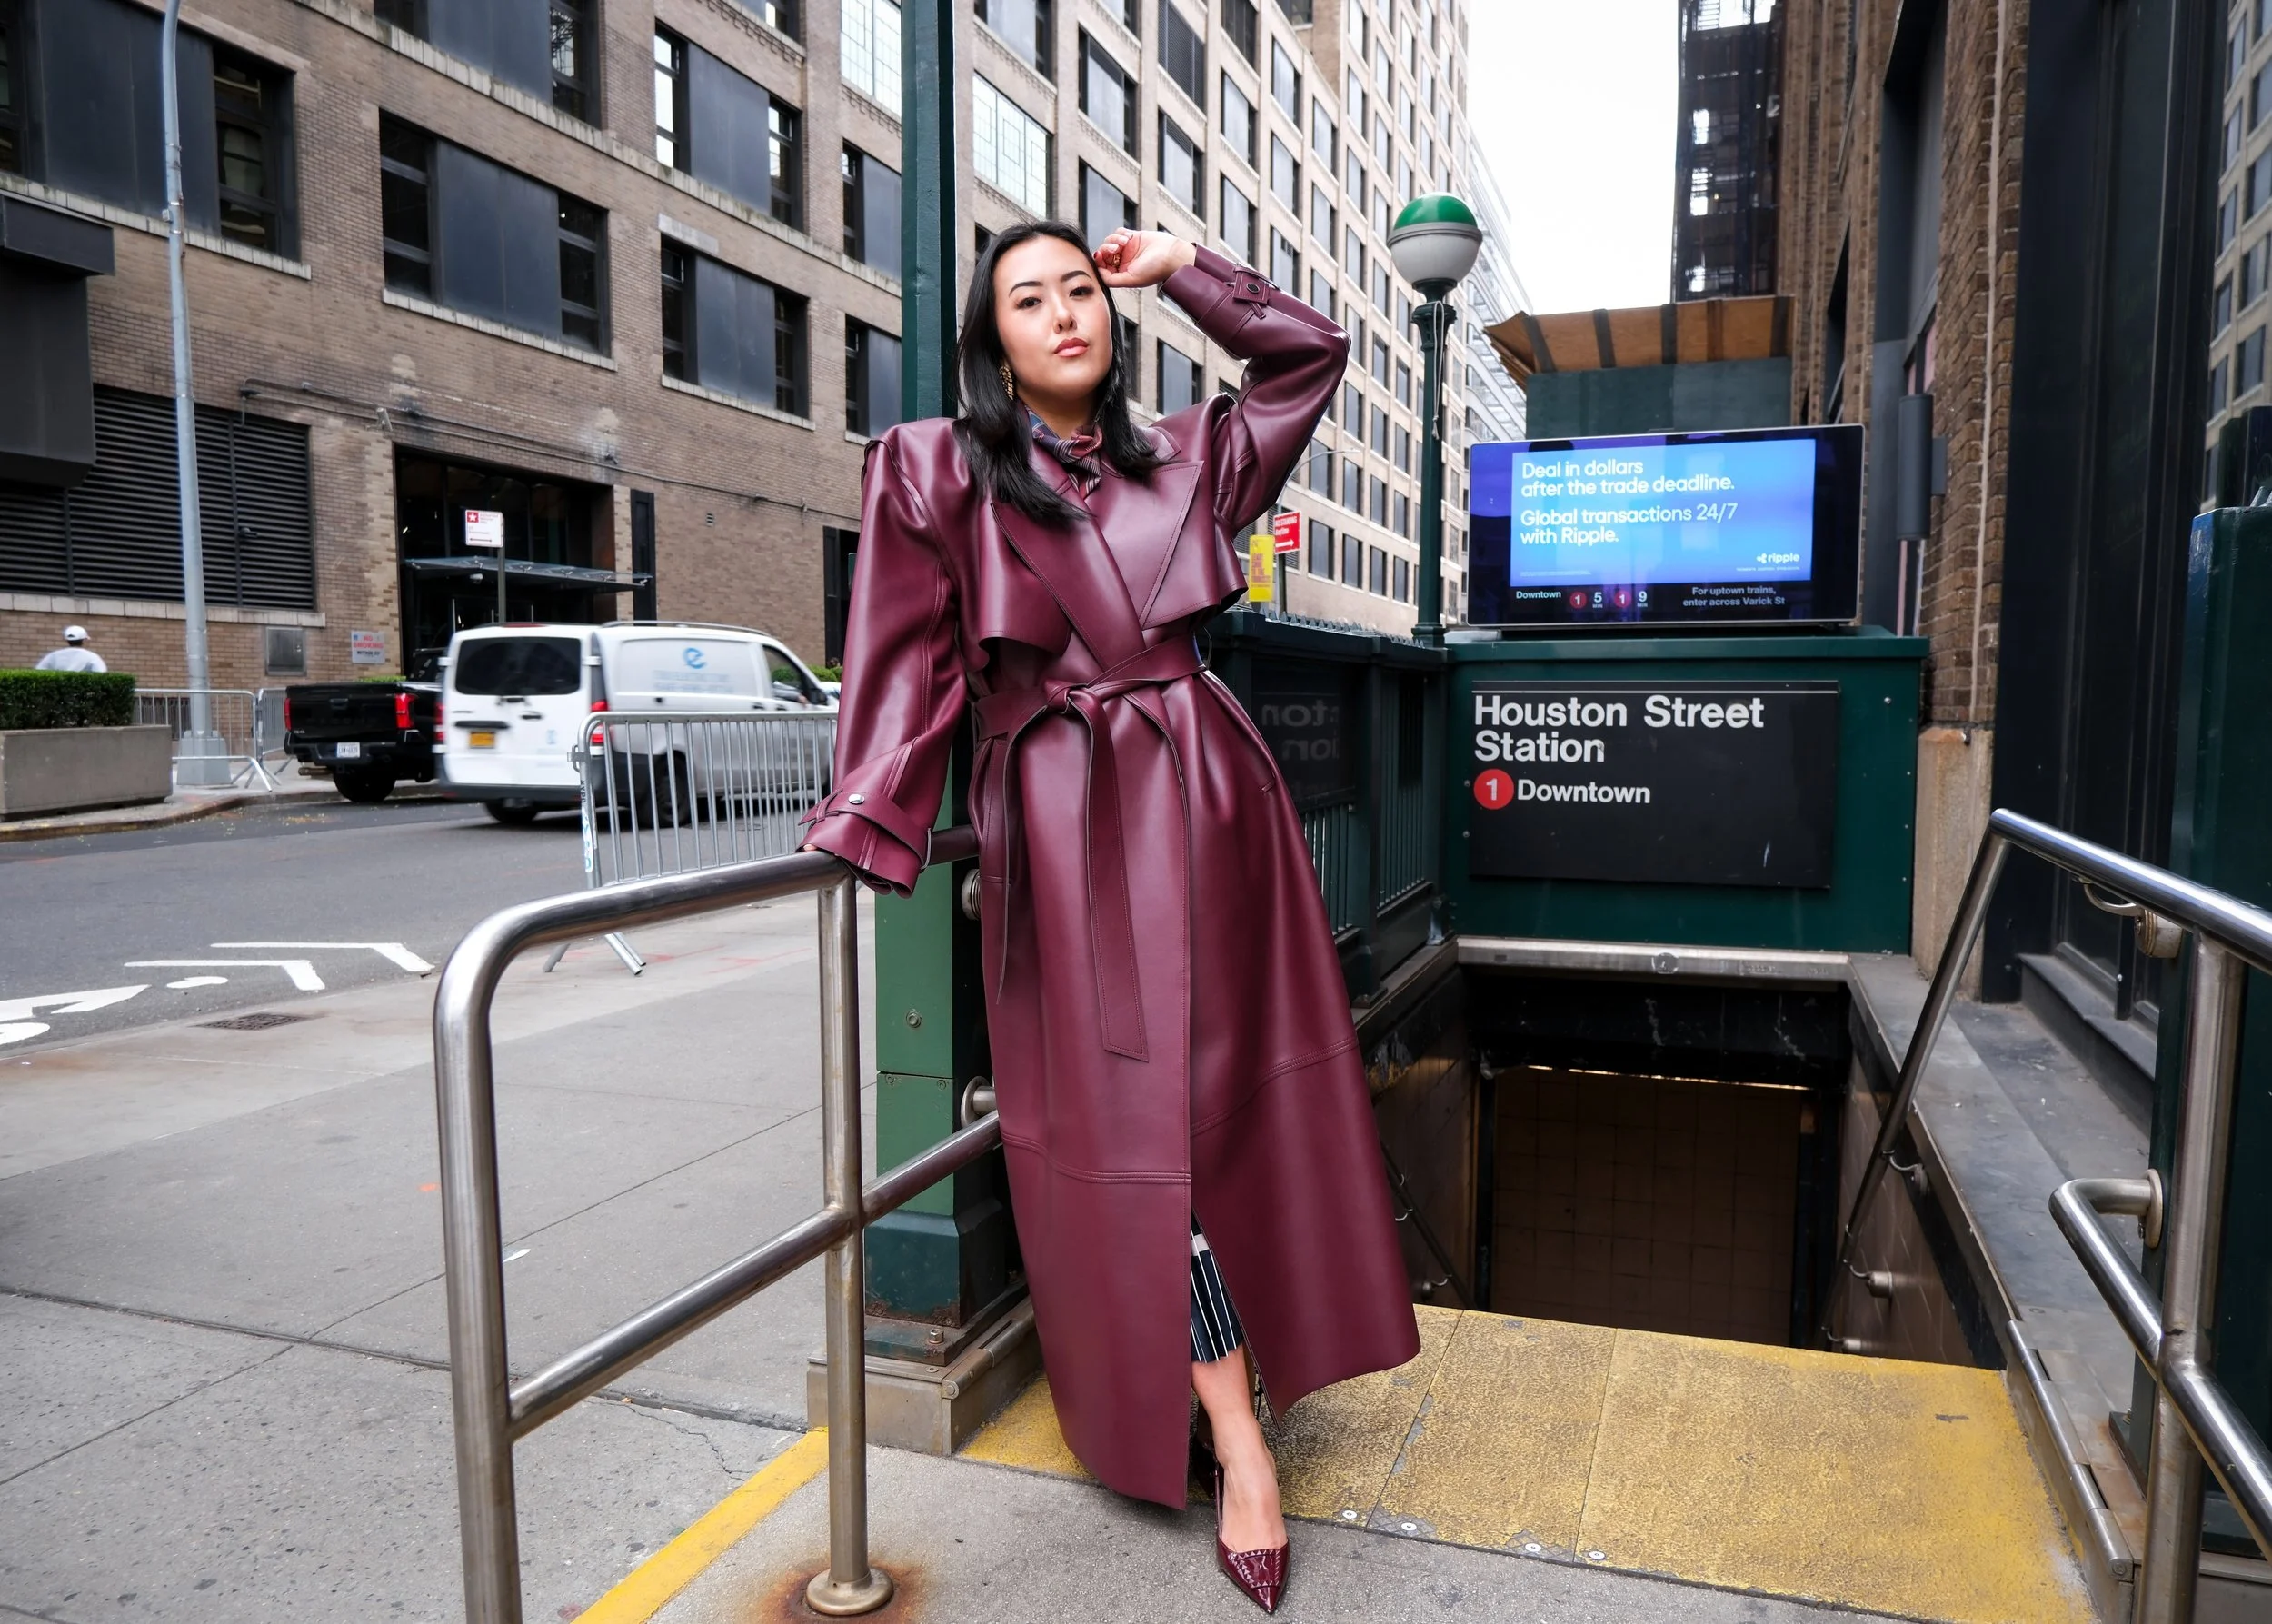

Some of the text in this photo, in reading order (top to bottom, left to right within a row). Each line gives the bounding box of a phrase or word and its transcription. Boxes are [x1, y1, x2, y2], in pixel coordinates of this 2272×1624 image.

[1522, 459, 1643, 479] Deal in dollars
[1520, 474, 1735, 497] after the trade deadline.
[1520, 503, 1739, 526] Global transactions 24/7
[1520, 526, 1619, 547] with Ripple.
[1768, 552, 1800, 564] ripple
[1516, 591, 1561, 599] Downtown
[1593, 592, 1603, 603] 5
[1639, 591, 1648, 603] 9
[1682, 598, 1708, 606] enter
[1742, 596, 1773, 605] Varick
[1774, 596, 1786, 605] St
[1692, 585, 1777, 596] For uptown trains,
[1475, 694, 1765, 729] Houston Street
[1474, 730, 1605, 763] Station
[1486, 778, 1650, 804] 1 Downtown
